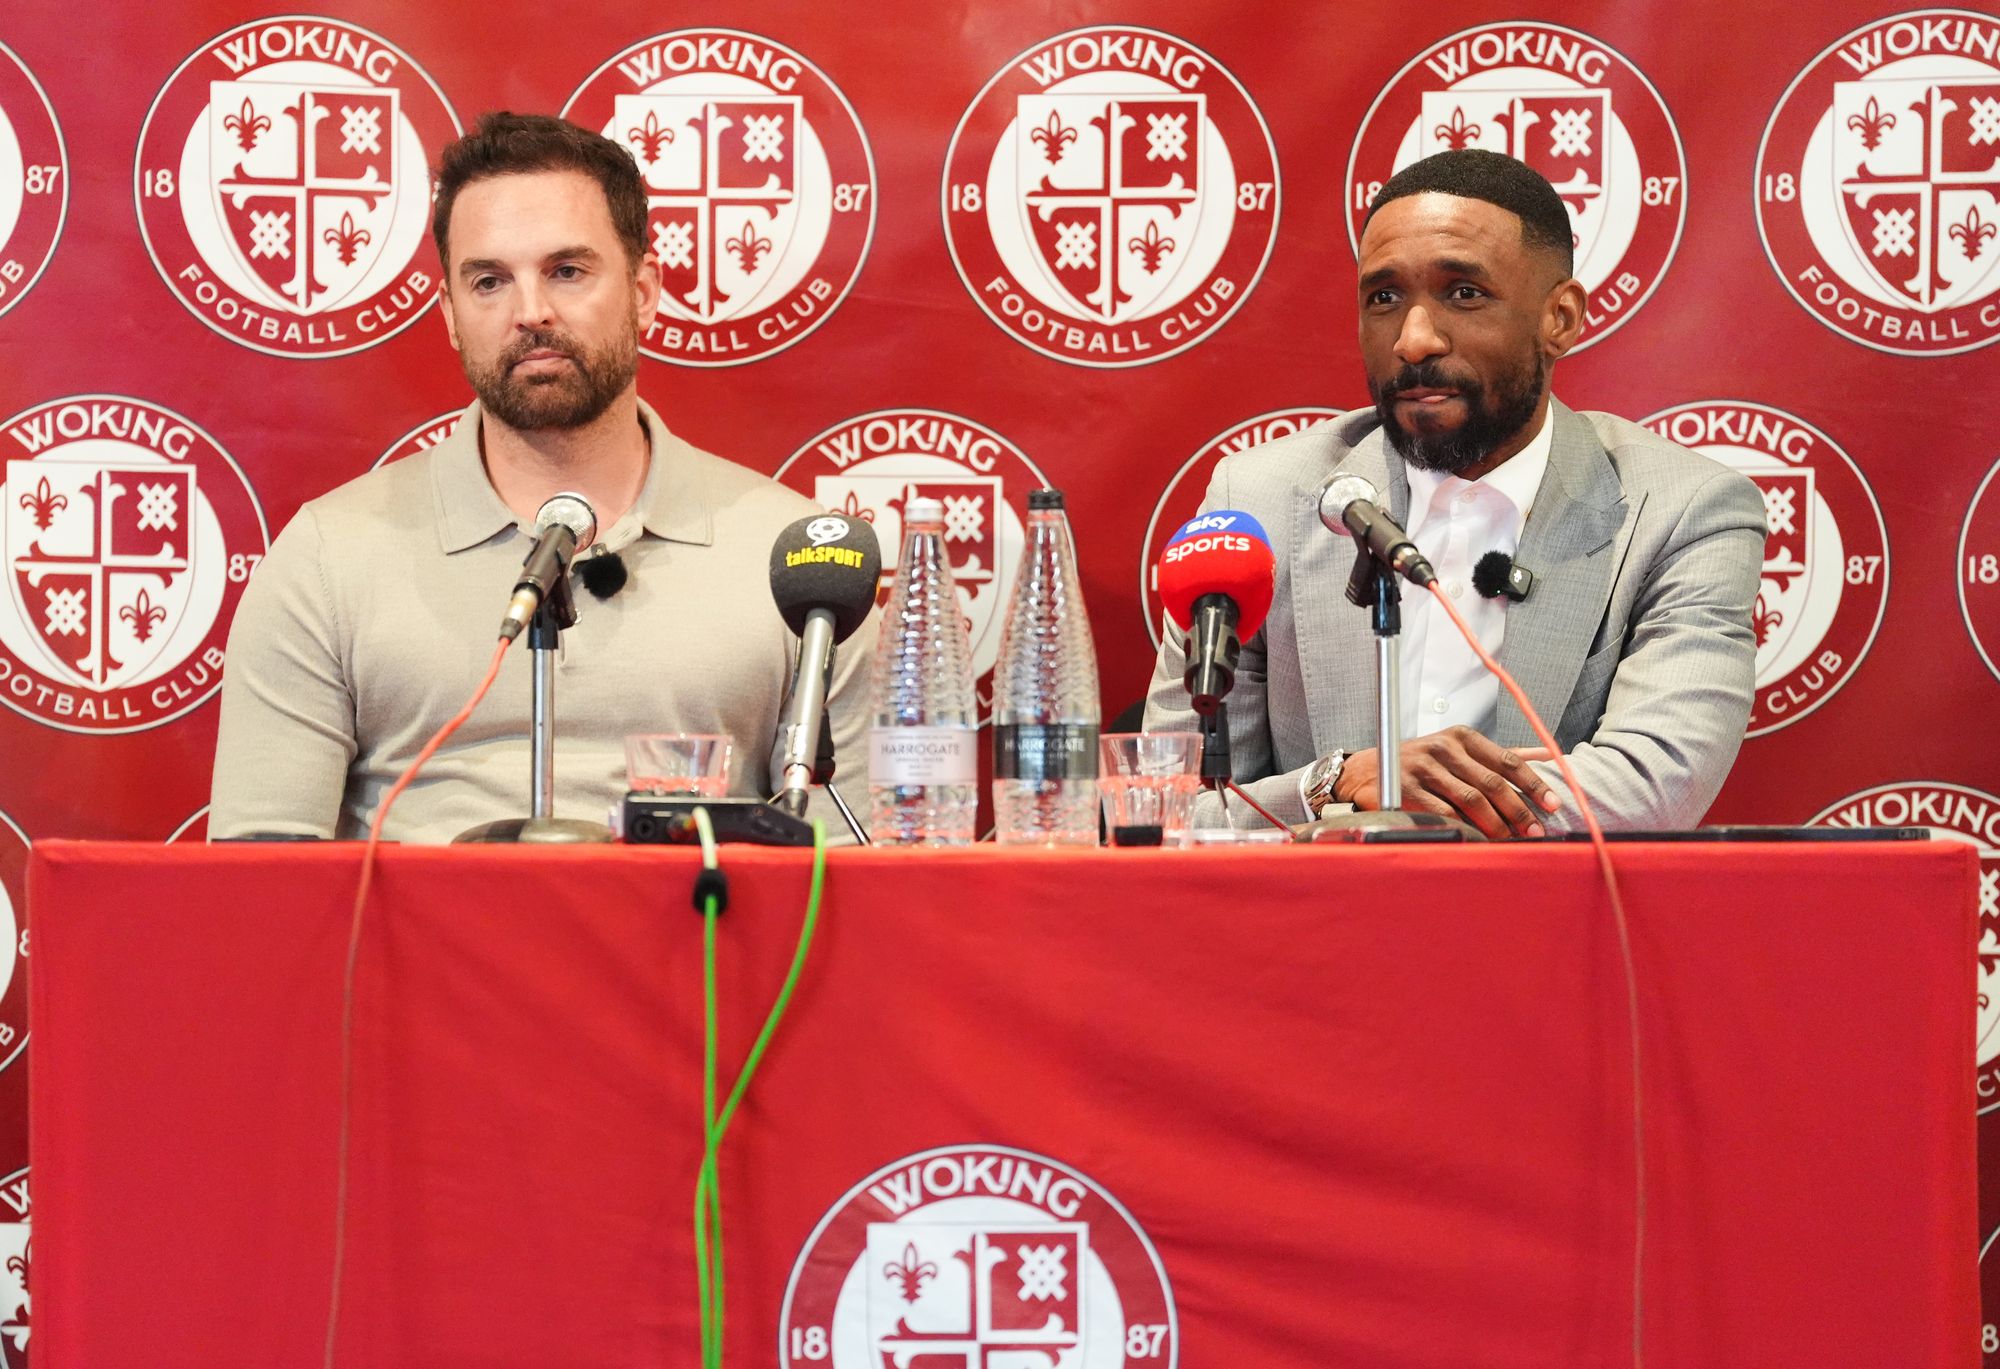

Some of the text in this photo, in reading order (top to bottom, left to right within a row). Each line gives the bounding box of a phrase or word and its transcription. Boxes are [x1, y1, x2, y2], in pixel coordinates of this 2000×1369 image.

[212, 25, 399, 84] WOKING
[616, 37, 802, 91] WOKING
[1018, 35, 1206, 89] WOKING
[1425, 31, 1611, 85] WOKING
[1837, 19, 2000, 74] WOKIN
[24, 164, 62, 195] 87
[144, 168, 175, 198] 18
[832, 182, 870, 212] 87
[1236, 182, 1273, 211] 87
[1642, 176, 1680, 206] 87
[1765, 172, 1796, 203] 18
[952, 183, 982, 212] 18
[179, 263, 431, 344] FOOTBALL CLUB
[645, 278, 832, 353] TBALL CLUB
[985, 276, 1235, 354] FOOTBALL CLUB
[1581, 272, 1640, 335] LUB
[1799, 265, 1969, 341] FOOTBALL
[9, 403, 195, 460] WOKING
[817, 418, 1002, 472] WOKING
[1185, 515, 1237, 534] sky
[785, 546, 864, 568] talkSPORT
[1165, 534, 1250, 563] sports
[227, 553, 262, 583] 87
[1845, 555, 1882, 585] 87
[1968, 554, 2000, 584] 18
[0, 646, 224, 720] OOTBALL CLUB
[1767, 650, 1842, 713] CLUB
[881, 742, 961, 755] HARROGATE
[1004, 738, 1085, 752] HARROGATE
[868, 1155, 1087, 1218] WOKING
[791, 1325, 829, 1361] 18
[1125, 1324, 1168, 1358] 87
